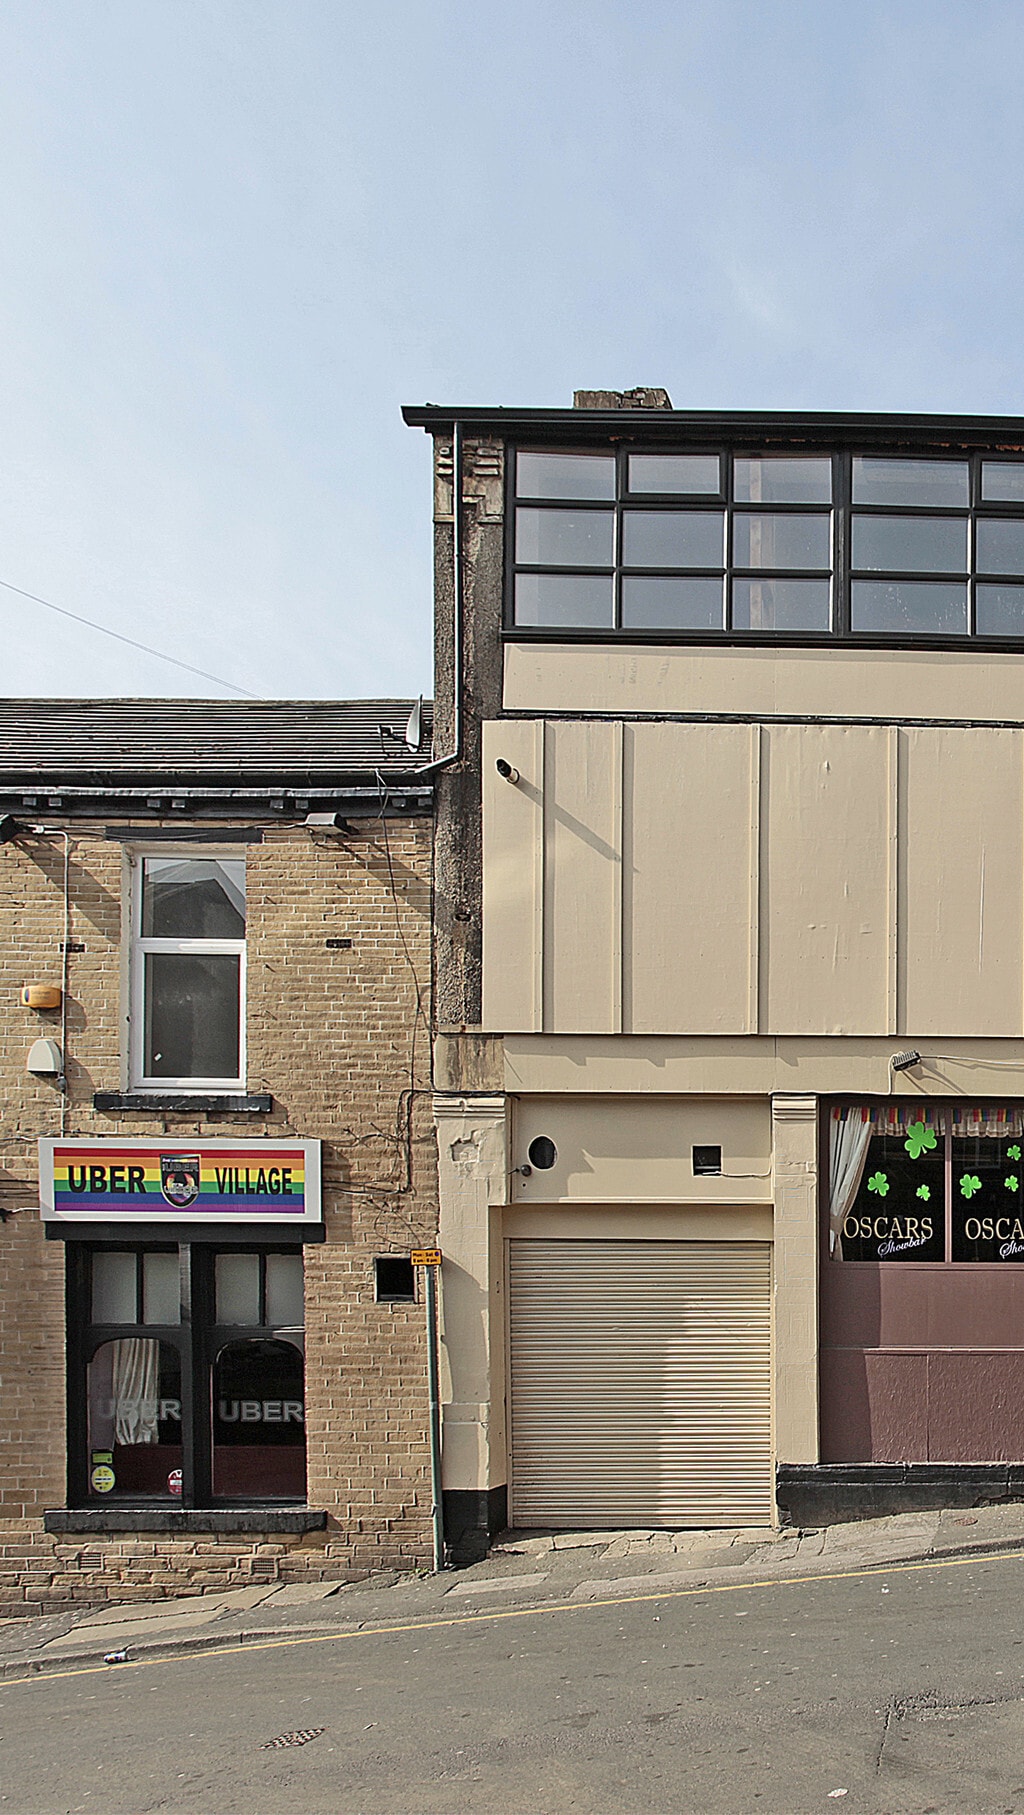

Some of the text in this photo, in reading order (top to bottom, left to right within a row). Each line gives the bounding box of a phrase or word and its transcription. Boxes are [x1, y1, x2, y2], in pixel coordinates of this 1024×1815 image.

[67, 1165, 293, 1195] UBER VILLAGE
[843, 1216, 934, 1240] OSCARS
[877, 1236, 926, 1258] Showbar
[100, 1398, 182, 1421] UBER
[218, 1400, 305, 1423] UBER
